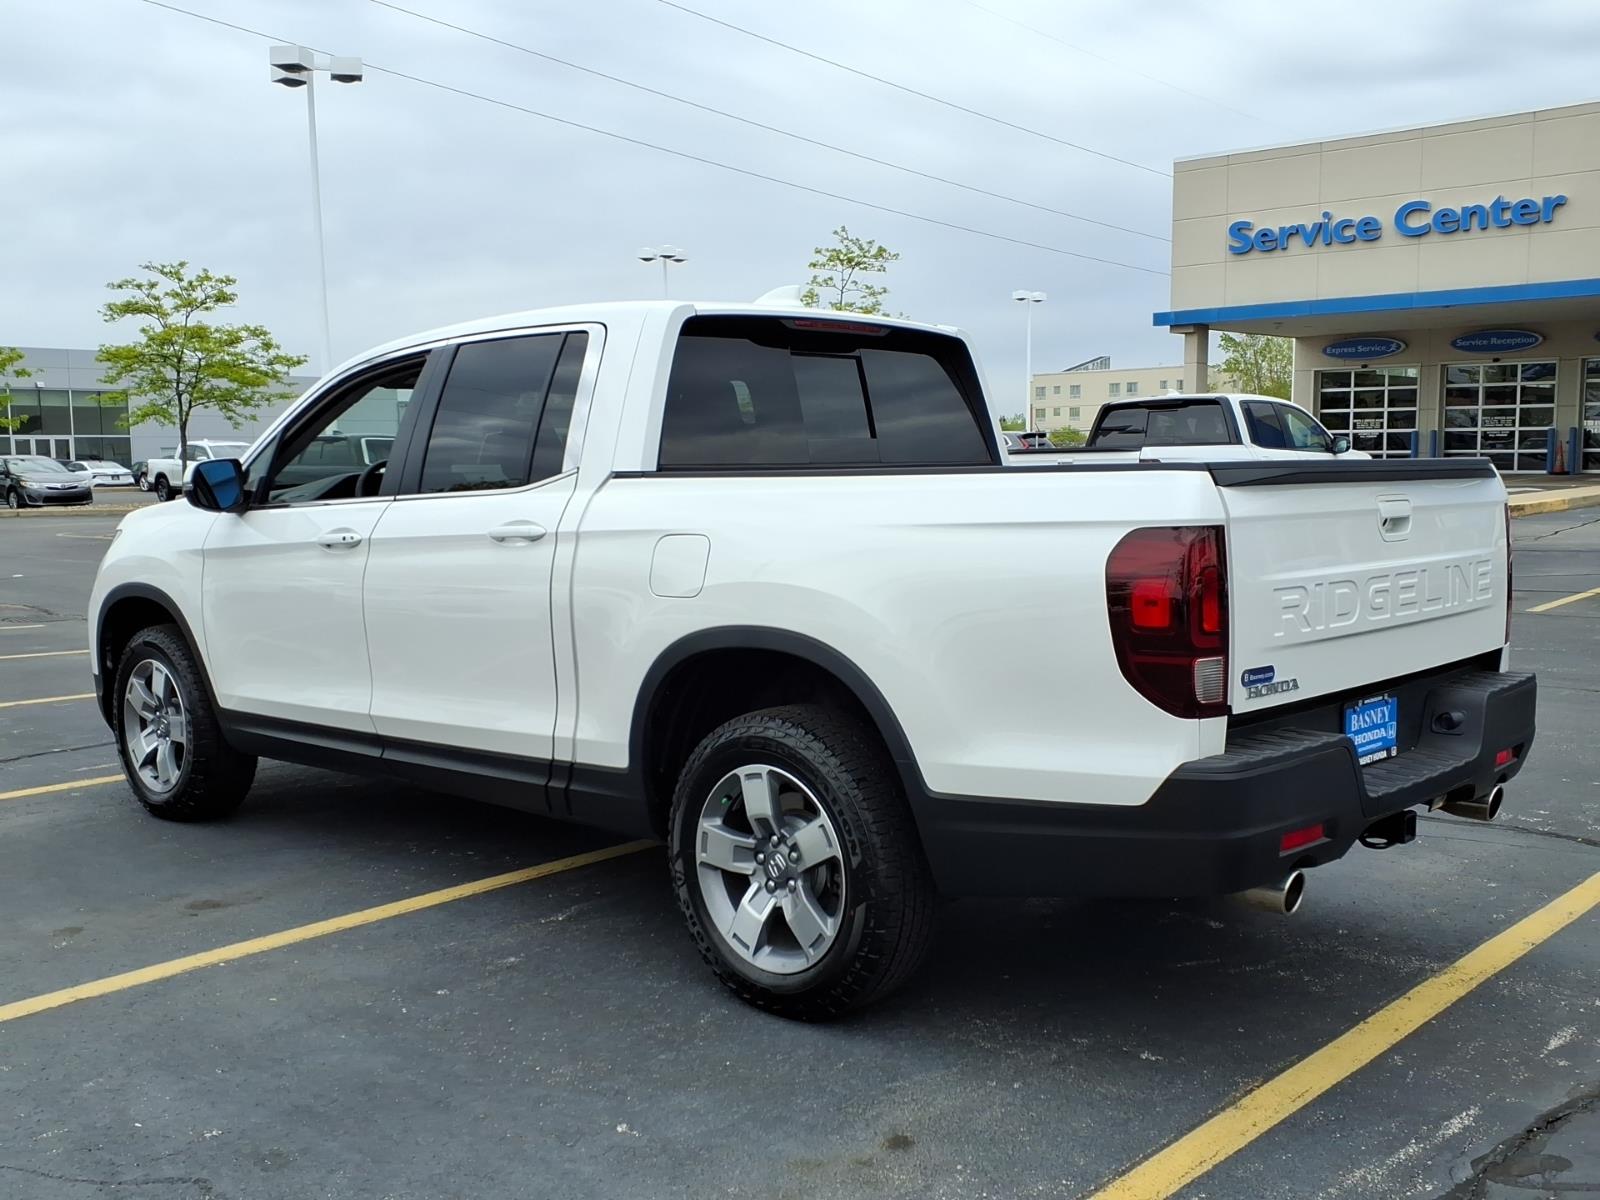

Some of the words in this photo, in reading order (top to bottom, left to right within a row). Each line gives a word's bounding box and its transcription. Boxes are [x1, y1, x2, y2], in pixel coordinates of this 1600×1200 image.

[1228, 211, 1382, 254] Service
[1394, 194, 1568, 237] Center
[1326, 346, 1356, 355] Express
[1357, 343, 1386, 353] Service
[1456, 339, 1488, 347] Service
[1491, 337, 1535, 346] Reception
[1273, 559, 1493, 636] RIDGELINE
[1245, 679, 1300, 700] HONDA
[1351, 705, 1390, 731] BASNEY
[1354, 727, 1387, 746] HONDA
